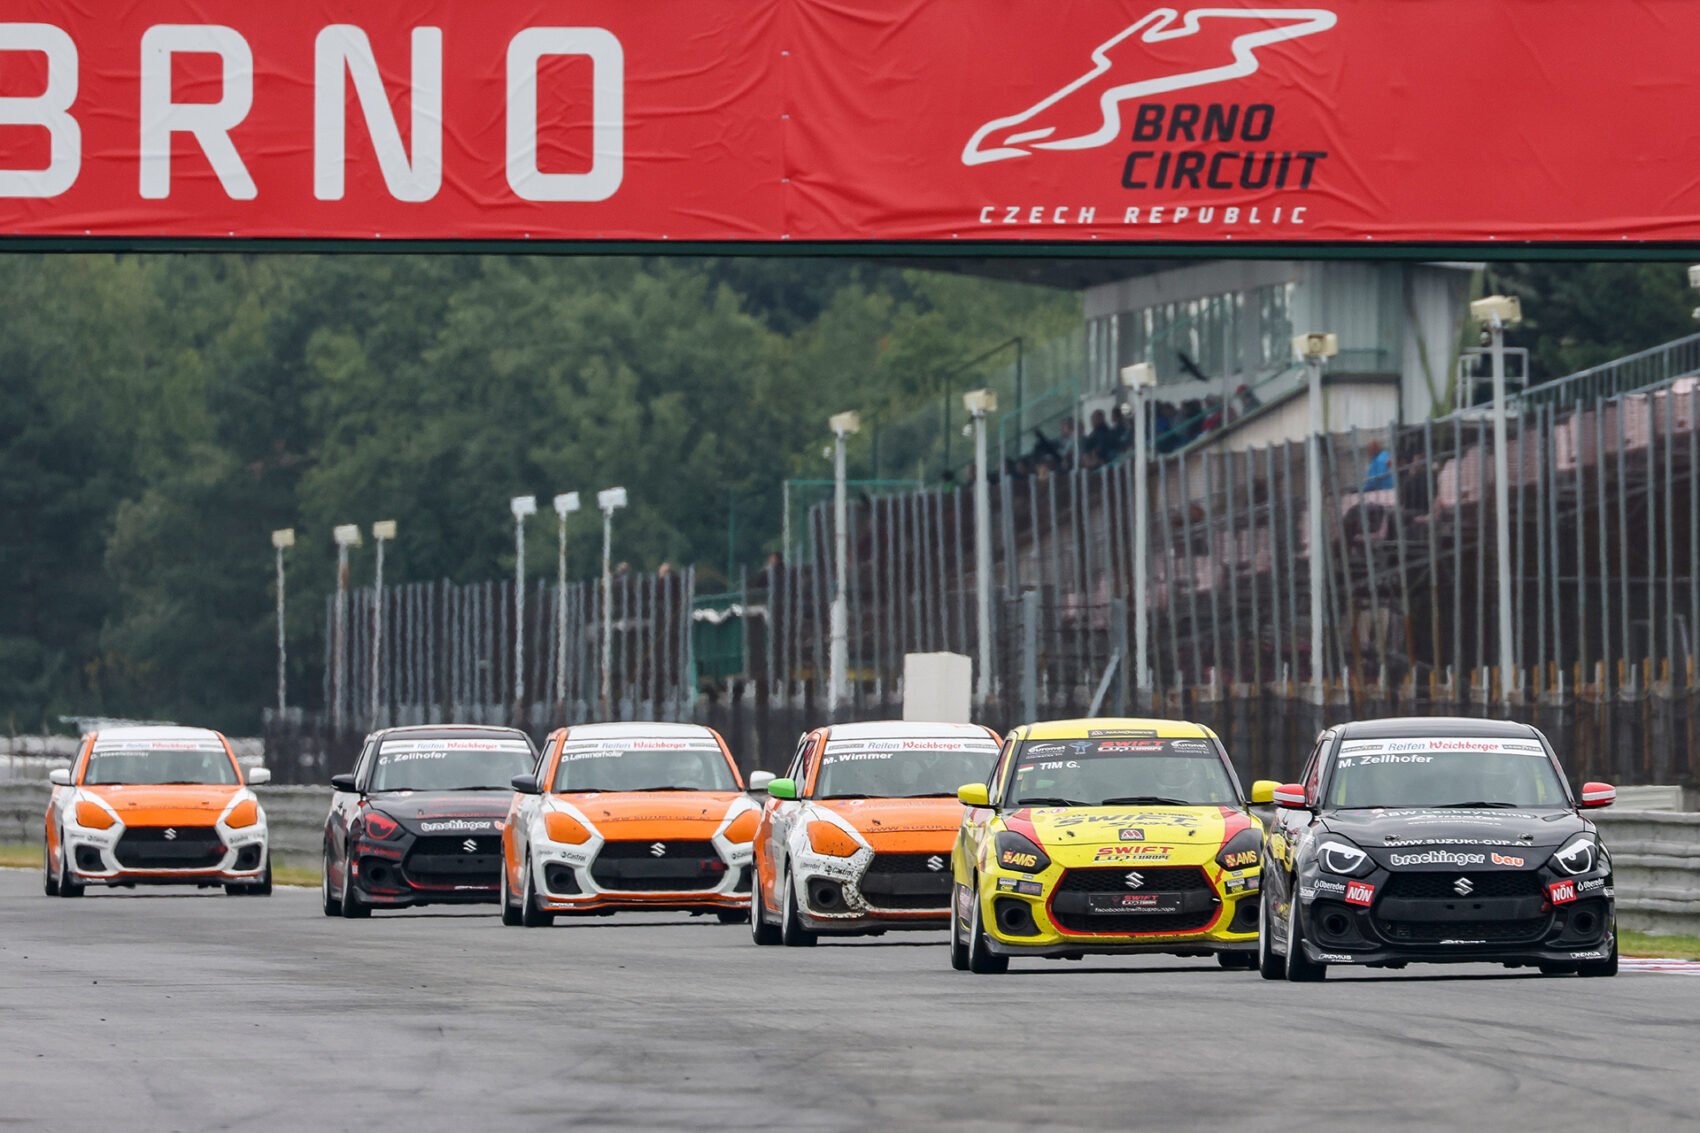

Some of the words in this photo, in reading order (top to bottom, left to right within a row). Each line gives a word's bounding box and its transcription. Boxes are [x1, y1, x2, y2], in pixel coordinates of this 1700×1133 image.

[0, 23, 625, 202] BRNO
[1132, 103, 1275, 142] BRNO
[1121, 151, 1328, 190] CIRCUIT
[979, 206, 1096, 224] CZECH
[1124, 206, 1308, 224] REPUBLIC
[867, 742, 900, 751] Reifen
[902, 741, 962, 751] Weichberger
[1388, 742, 1426, 752] Reifen
[1429, 741, 1500, 752] Weichberger
[394, 751, 448, 763] Zellhofer
[839, 752, 894, 763] Wimmer
[1338, 758, 1356, 769] M.
[1360, 753, 1434, 765] Zellhofer
[1039, 761, 1063, 771] TIM
[1066, 760, 1081, 769] G.
[1383, 838, 1534, 847] WWW.SUZUKI-CUP.AT
[1096, 846, 1175, 856] SWIFT
[1236, 850, 1258, 866] AMS
[1391, 850, 1486, 867] brachinger
[1491, 853, 1525, 867] bau
[1011, 852, 1038, 868] AMS
[1320, 880, 1347, 891] Obereder
[1552, 884, 1574, 902] NÖN
[1347, 885, 1373, 903] NÖN
